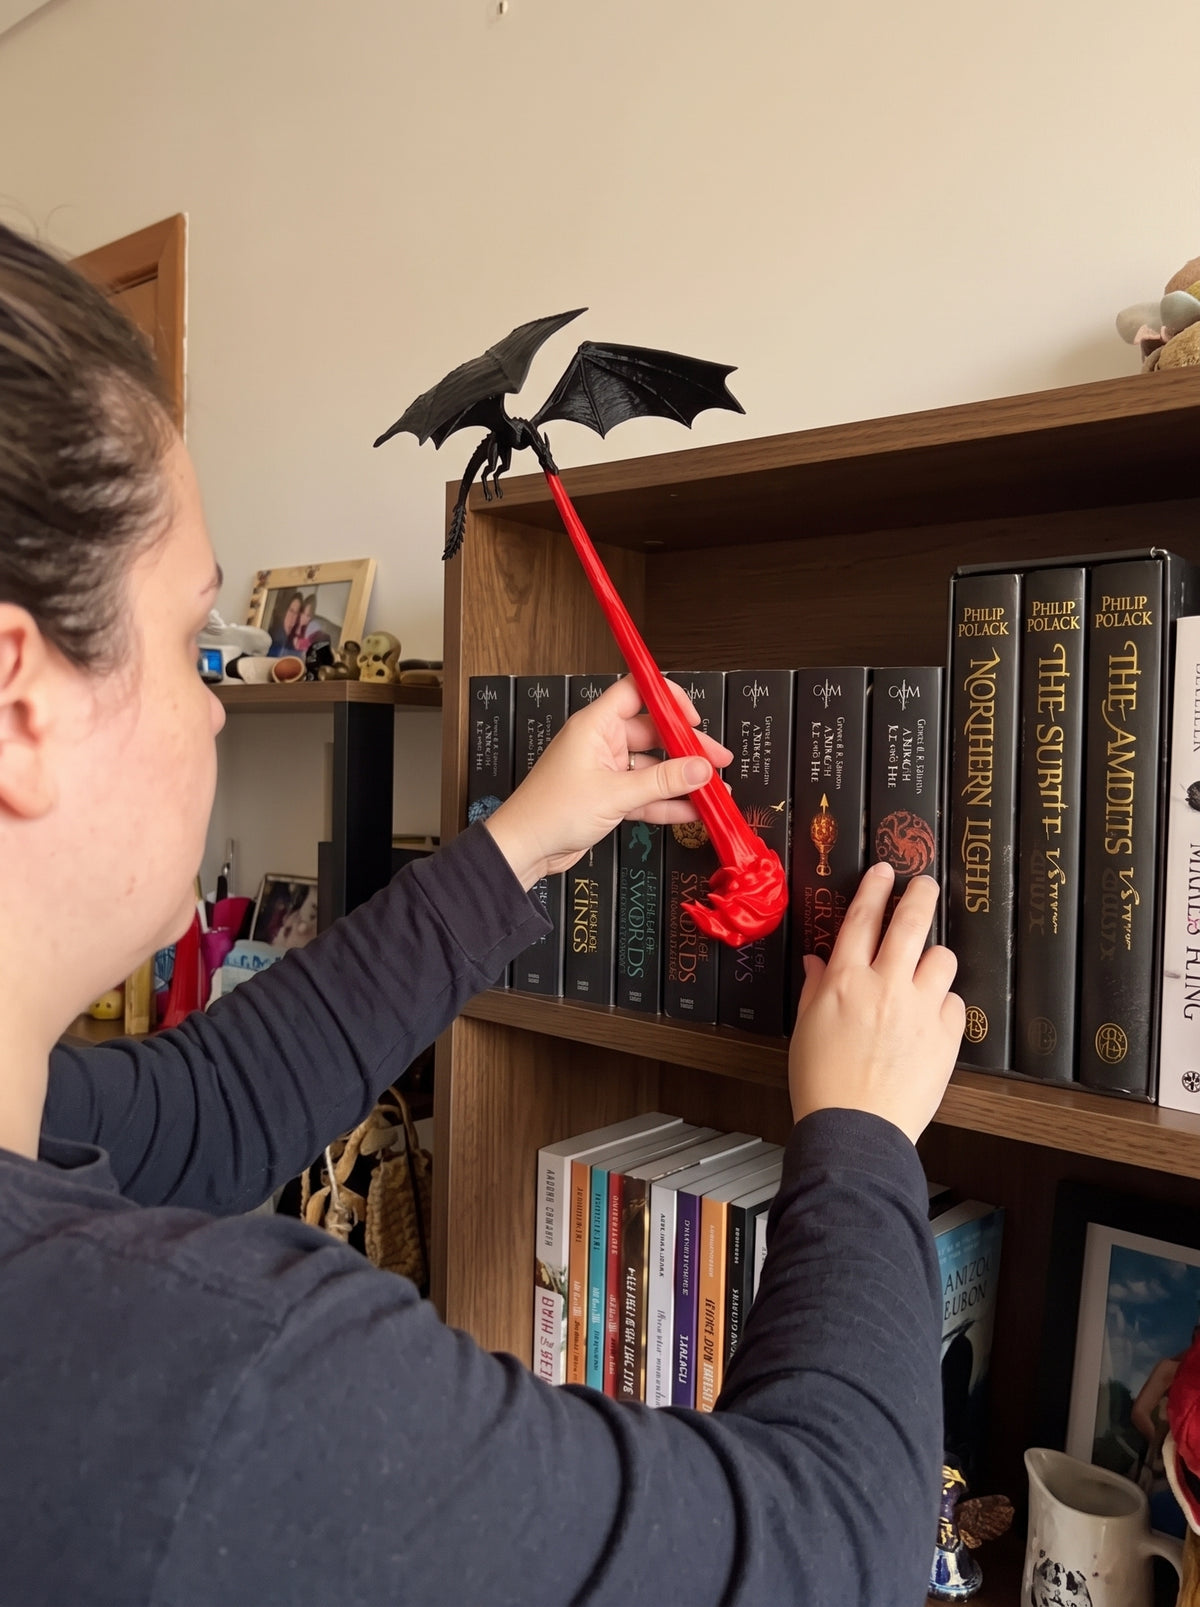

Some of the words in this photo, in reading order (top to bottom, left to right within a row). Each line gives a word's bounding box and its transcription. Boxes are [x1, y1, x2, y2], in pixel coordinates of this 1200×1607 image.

[1032, 600, 1076, 616] PHILIP
[1102, 595, 1148, 612] PHILIP
[964, 607, 1005, 623] PHILIP
[1027, 615, 1080, 632] POLACK
[1095, 611, 1153, 629] POLACK
[958, 621, 1009, 637] POLACK
[1037, 643, 1070, 722] THE
[1107, 640, 1142, 722] THE
[961, 646, 1001, 808] NORTHERN
[573, 877, 590, 954] KINGS
[627, 868, 647, 980] SWORDS
